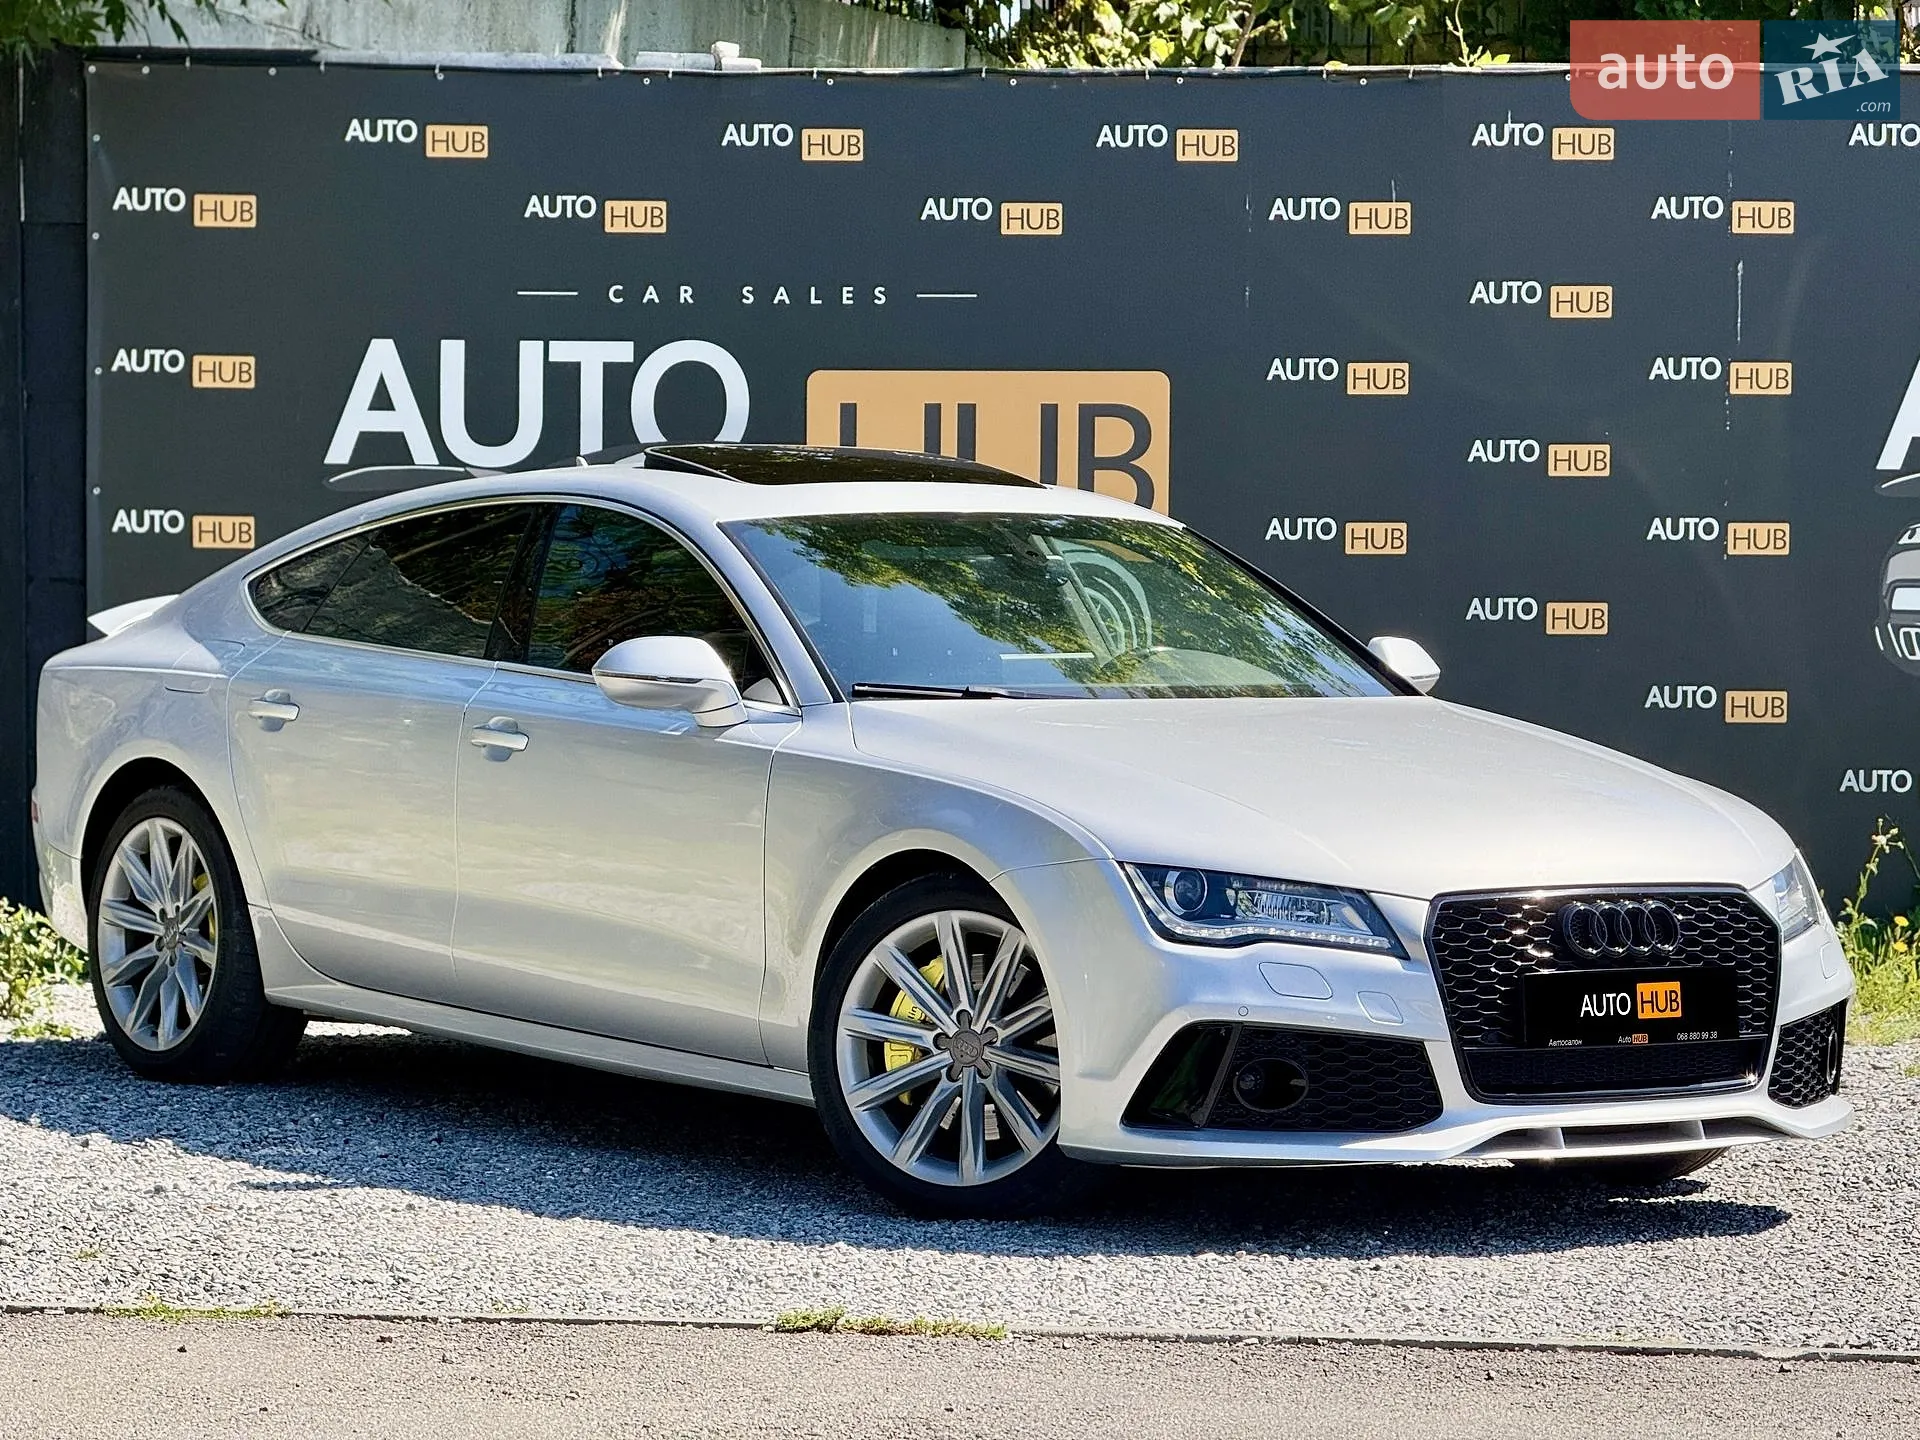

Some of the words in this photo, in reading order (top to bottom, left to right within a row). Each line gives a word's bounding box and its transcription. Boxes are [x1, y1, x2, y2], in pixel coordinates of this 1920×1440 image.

[345, 119, 417, 143] AUTO
[431, 131, 486, 153] HUB
[722, 124, 793, 146] AUTO
[807, 134, 861, 157] HUB
[1096, 125, 1168, 147] AUTO
[1182, 134, 1234, 157] HUB
[1472, 124, 1544, 147] AUTO
[1557, 133, 1610, 156] HUB
[1849, 123, 1920, 146] AUTO
[113, 187, 186, 212] AUTO
[199, 200, 254, 223] HUB
[524, 195, 596, 218] AUTO
[610, 206, 664, 228] HUB
[921, 198, 992, 220] AUTO
[1006, 208, 1059, 231] HUB
[1269, 198, 1340, 220] AUTO
[1354, 207, 1408, 230] HUB
[1651, 196, 1724, 219] AUTO
[1737, 206, 1791, 229] HUB
[609, 285, 693, 304] CAR
[742, 285, 887, 305] SALES
[1470, 281, 1542, 304] AUTO
[1556, 291, 1609, 314] HUB
[111, 349, 185, 373] AUTO
[198, 360, 253, 384] HUB
[1267, 358, 1339, 380] AUTO
[1352, 368, 1406, 390] HUB
[1649, 357, 1721, 380] AUTO
[1735, 367, 1789, 390] HUB
[323, 338, 750, 467] AUTO
[1468, 440, 1539, 462] AUTO
[1553, 449, 1607, 472] HUB
[112, 509, 184, 533] AUTO
[198, 521, 252, 544] HUB
[1265, 518, 1336, 540] AUTO
[1350, 527, 1405, 550] HUB
[1647, 518, 1719, 540] AUTO
[1733, 528, 1787, 550] HUB
[1466, 598, 1537, 620] AUTO
[1551, 607, 1605, 630] HUB
[1645, 686, 1717, 708] AUTO
[1730, 696, 1785, 719] HUB
[1840, 769, 1912, 793] AUTO
[1580, 992, 1631, 1017] AUTO
[1640, 990, 1679, 1014] HUB
[1548, 1039, 1583, 1047] Автосалон
[1617, 1035, 1632, 1044] Auto
[1633, 1034, 1648, 1043] HUB
